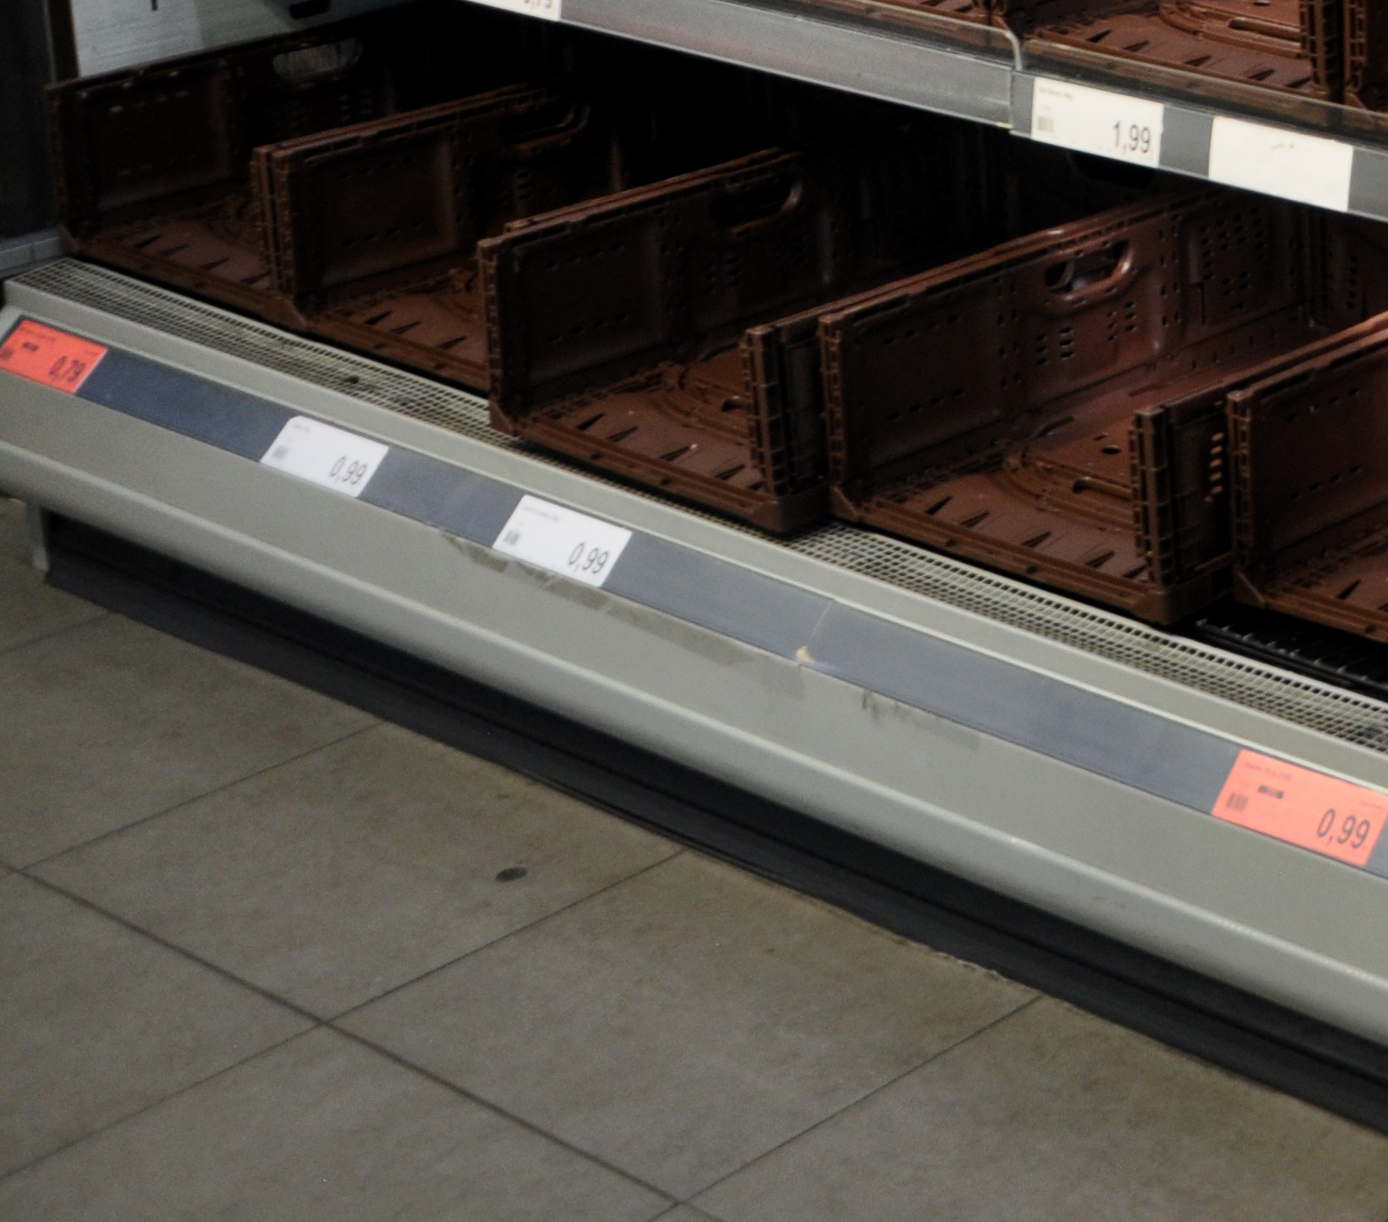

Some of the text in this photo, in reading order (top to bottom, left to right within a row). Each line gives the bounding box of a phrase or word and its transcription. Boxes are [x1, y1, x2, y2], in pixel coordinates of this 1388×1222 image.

[1113, 119, 1152, 155] 1,99
[329, 455, 369, 486] 0,99
[568, 541, 608, 574] 0,99
[1316, 807, 1371, 849] 0,99
